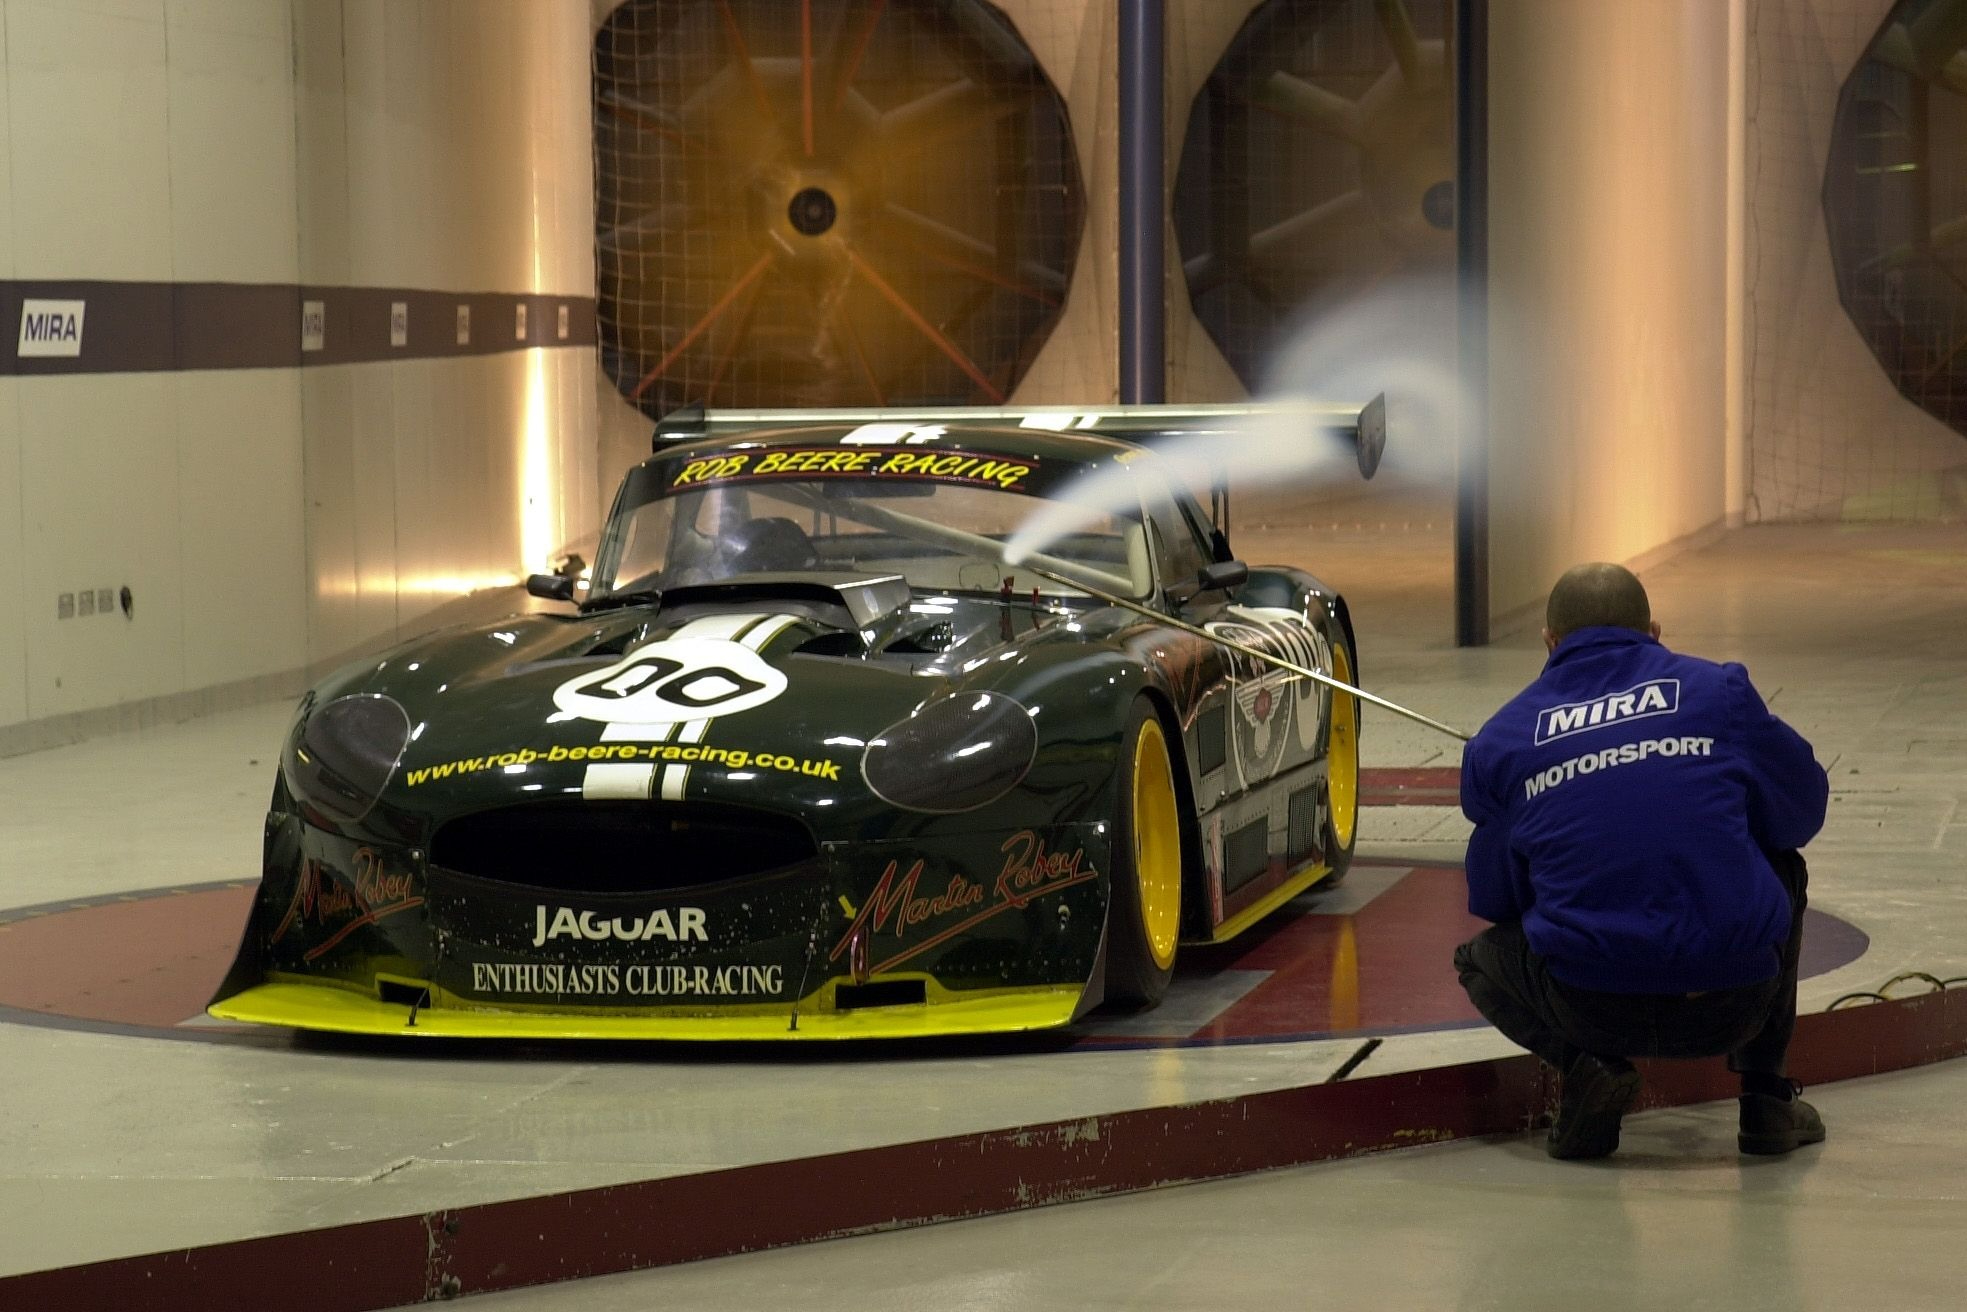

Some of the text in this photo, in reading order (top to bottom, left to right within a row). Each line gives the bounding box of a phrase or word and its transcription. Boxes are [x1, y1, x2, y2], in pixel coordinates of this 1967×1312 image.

[25, 313, 77, 341] MIRA
[673, 451, 1030, 489] ROB BEERE RACING
[1547, 685, 1669, 737] MIRA
[406, 744, 842, 787] www.rob-beere-racing.co.uk
[1524, 737, 1715, 801] MOTORSPORT
[531, 904, 709, 947] JAGUAR
[828, 858, 984, 962] Martin
[472, 962, 784, 996] ENTHUSIASTS CLUB-RACING
